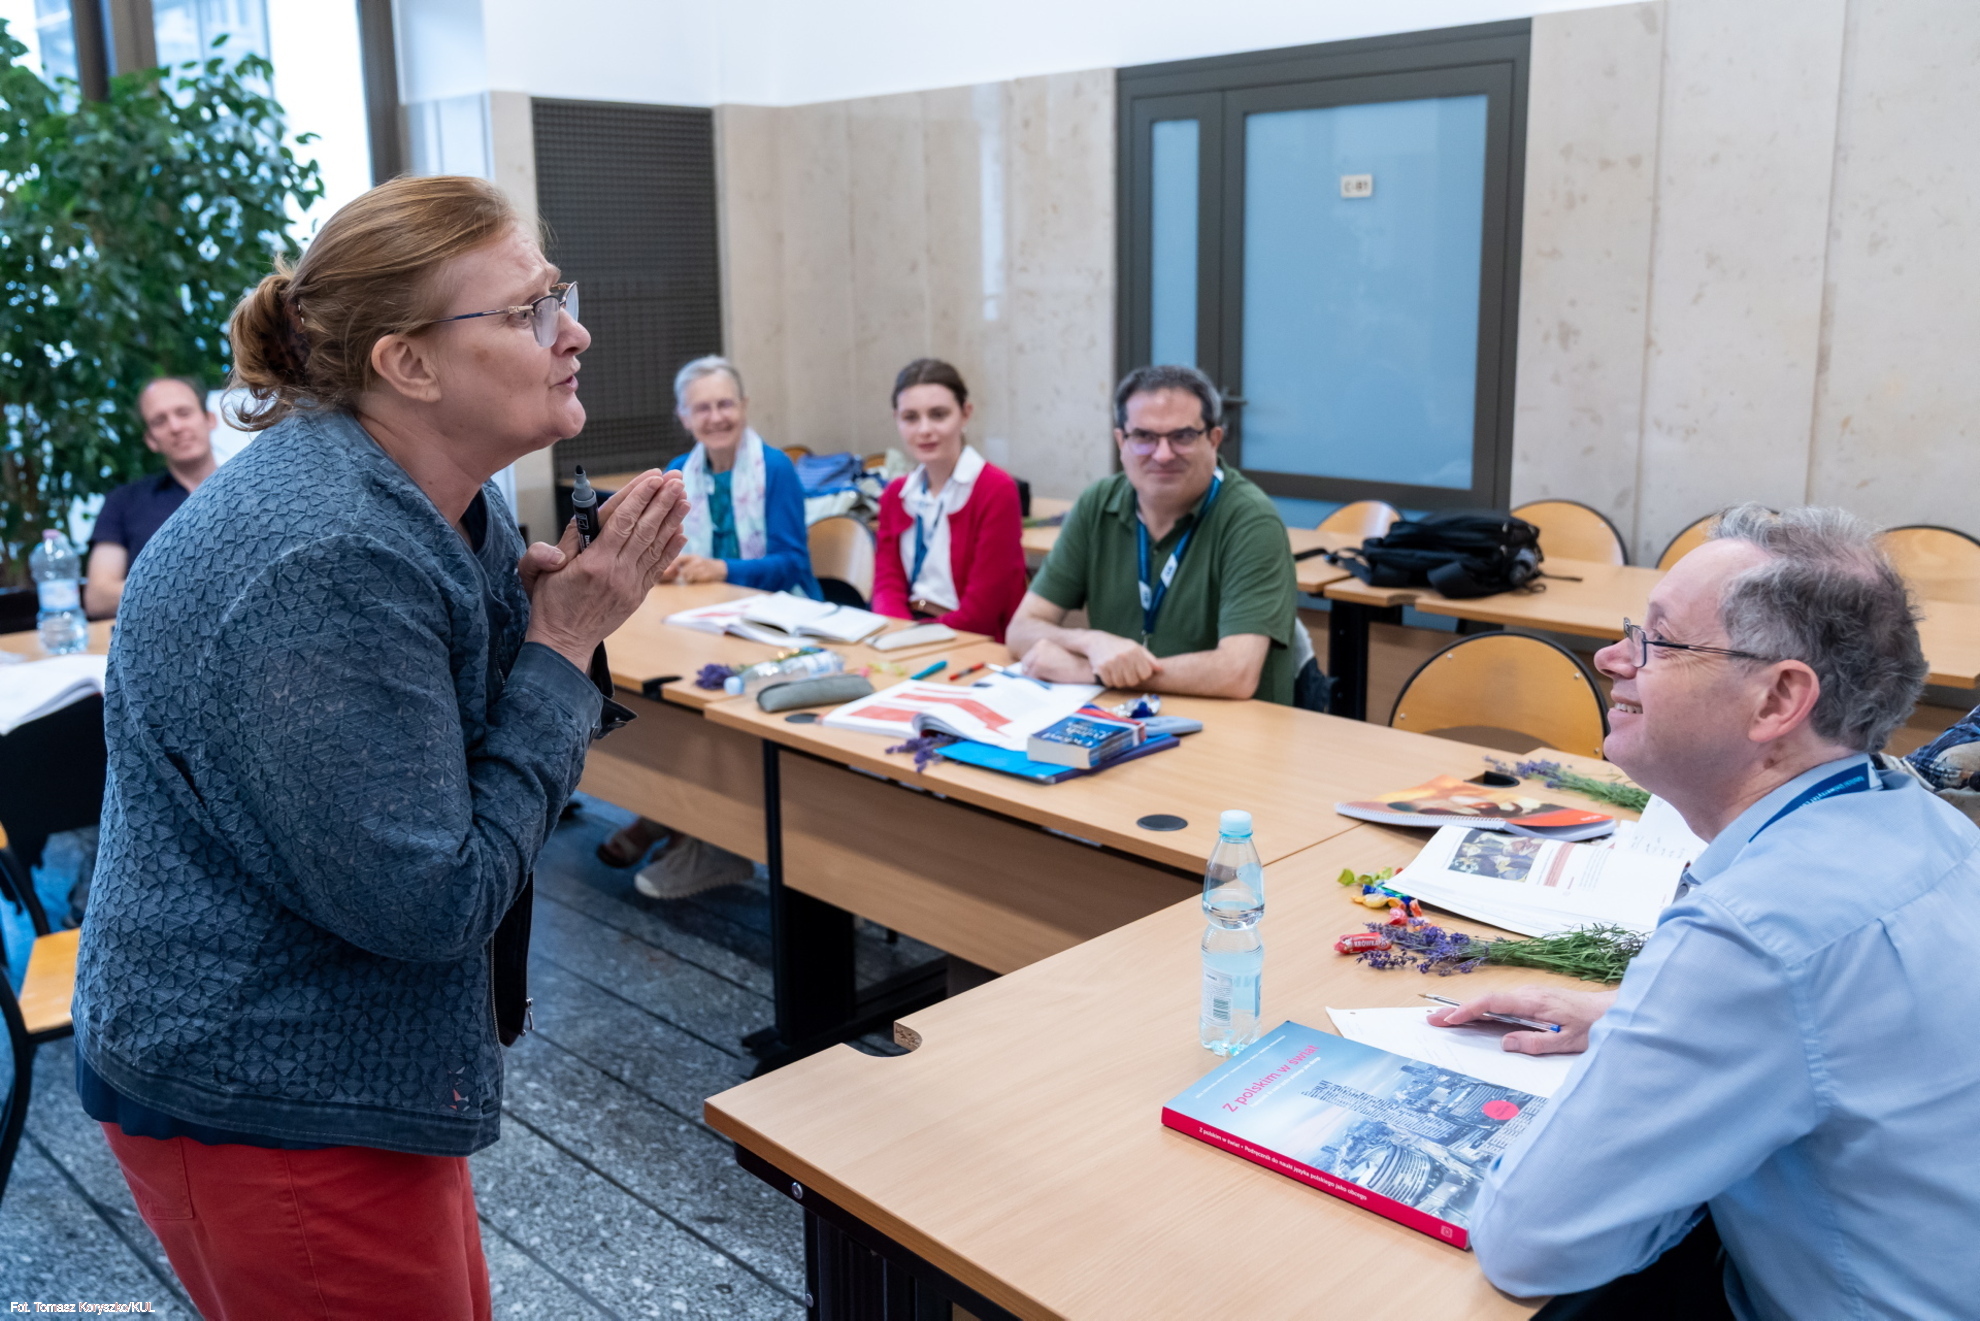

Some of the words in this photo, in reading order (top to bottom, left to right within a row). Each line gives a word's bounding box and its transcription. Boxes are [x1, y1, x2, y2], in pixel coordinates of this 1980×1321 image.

[1222, 1102, 1239, 1113] Z
[1234, 1072, 1282, 1106] polskim
[1276, 1064, 1291, 1073] w
[1286, 1044, 1320, 1066] świat
[1203, 1129, 1222, 1141] polskim
[1278, 1160, 1293, 1170] nauki
[1310, 1173, 1335, 1187] polskiego
[1334, 1183, 1347, 1192] jako
[1347, 1189, 1368, 1201] obcego
